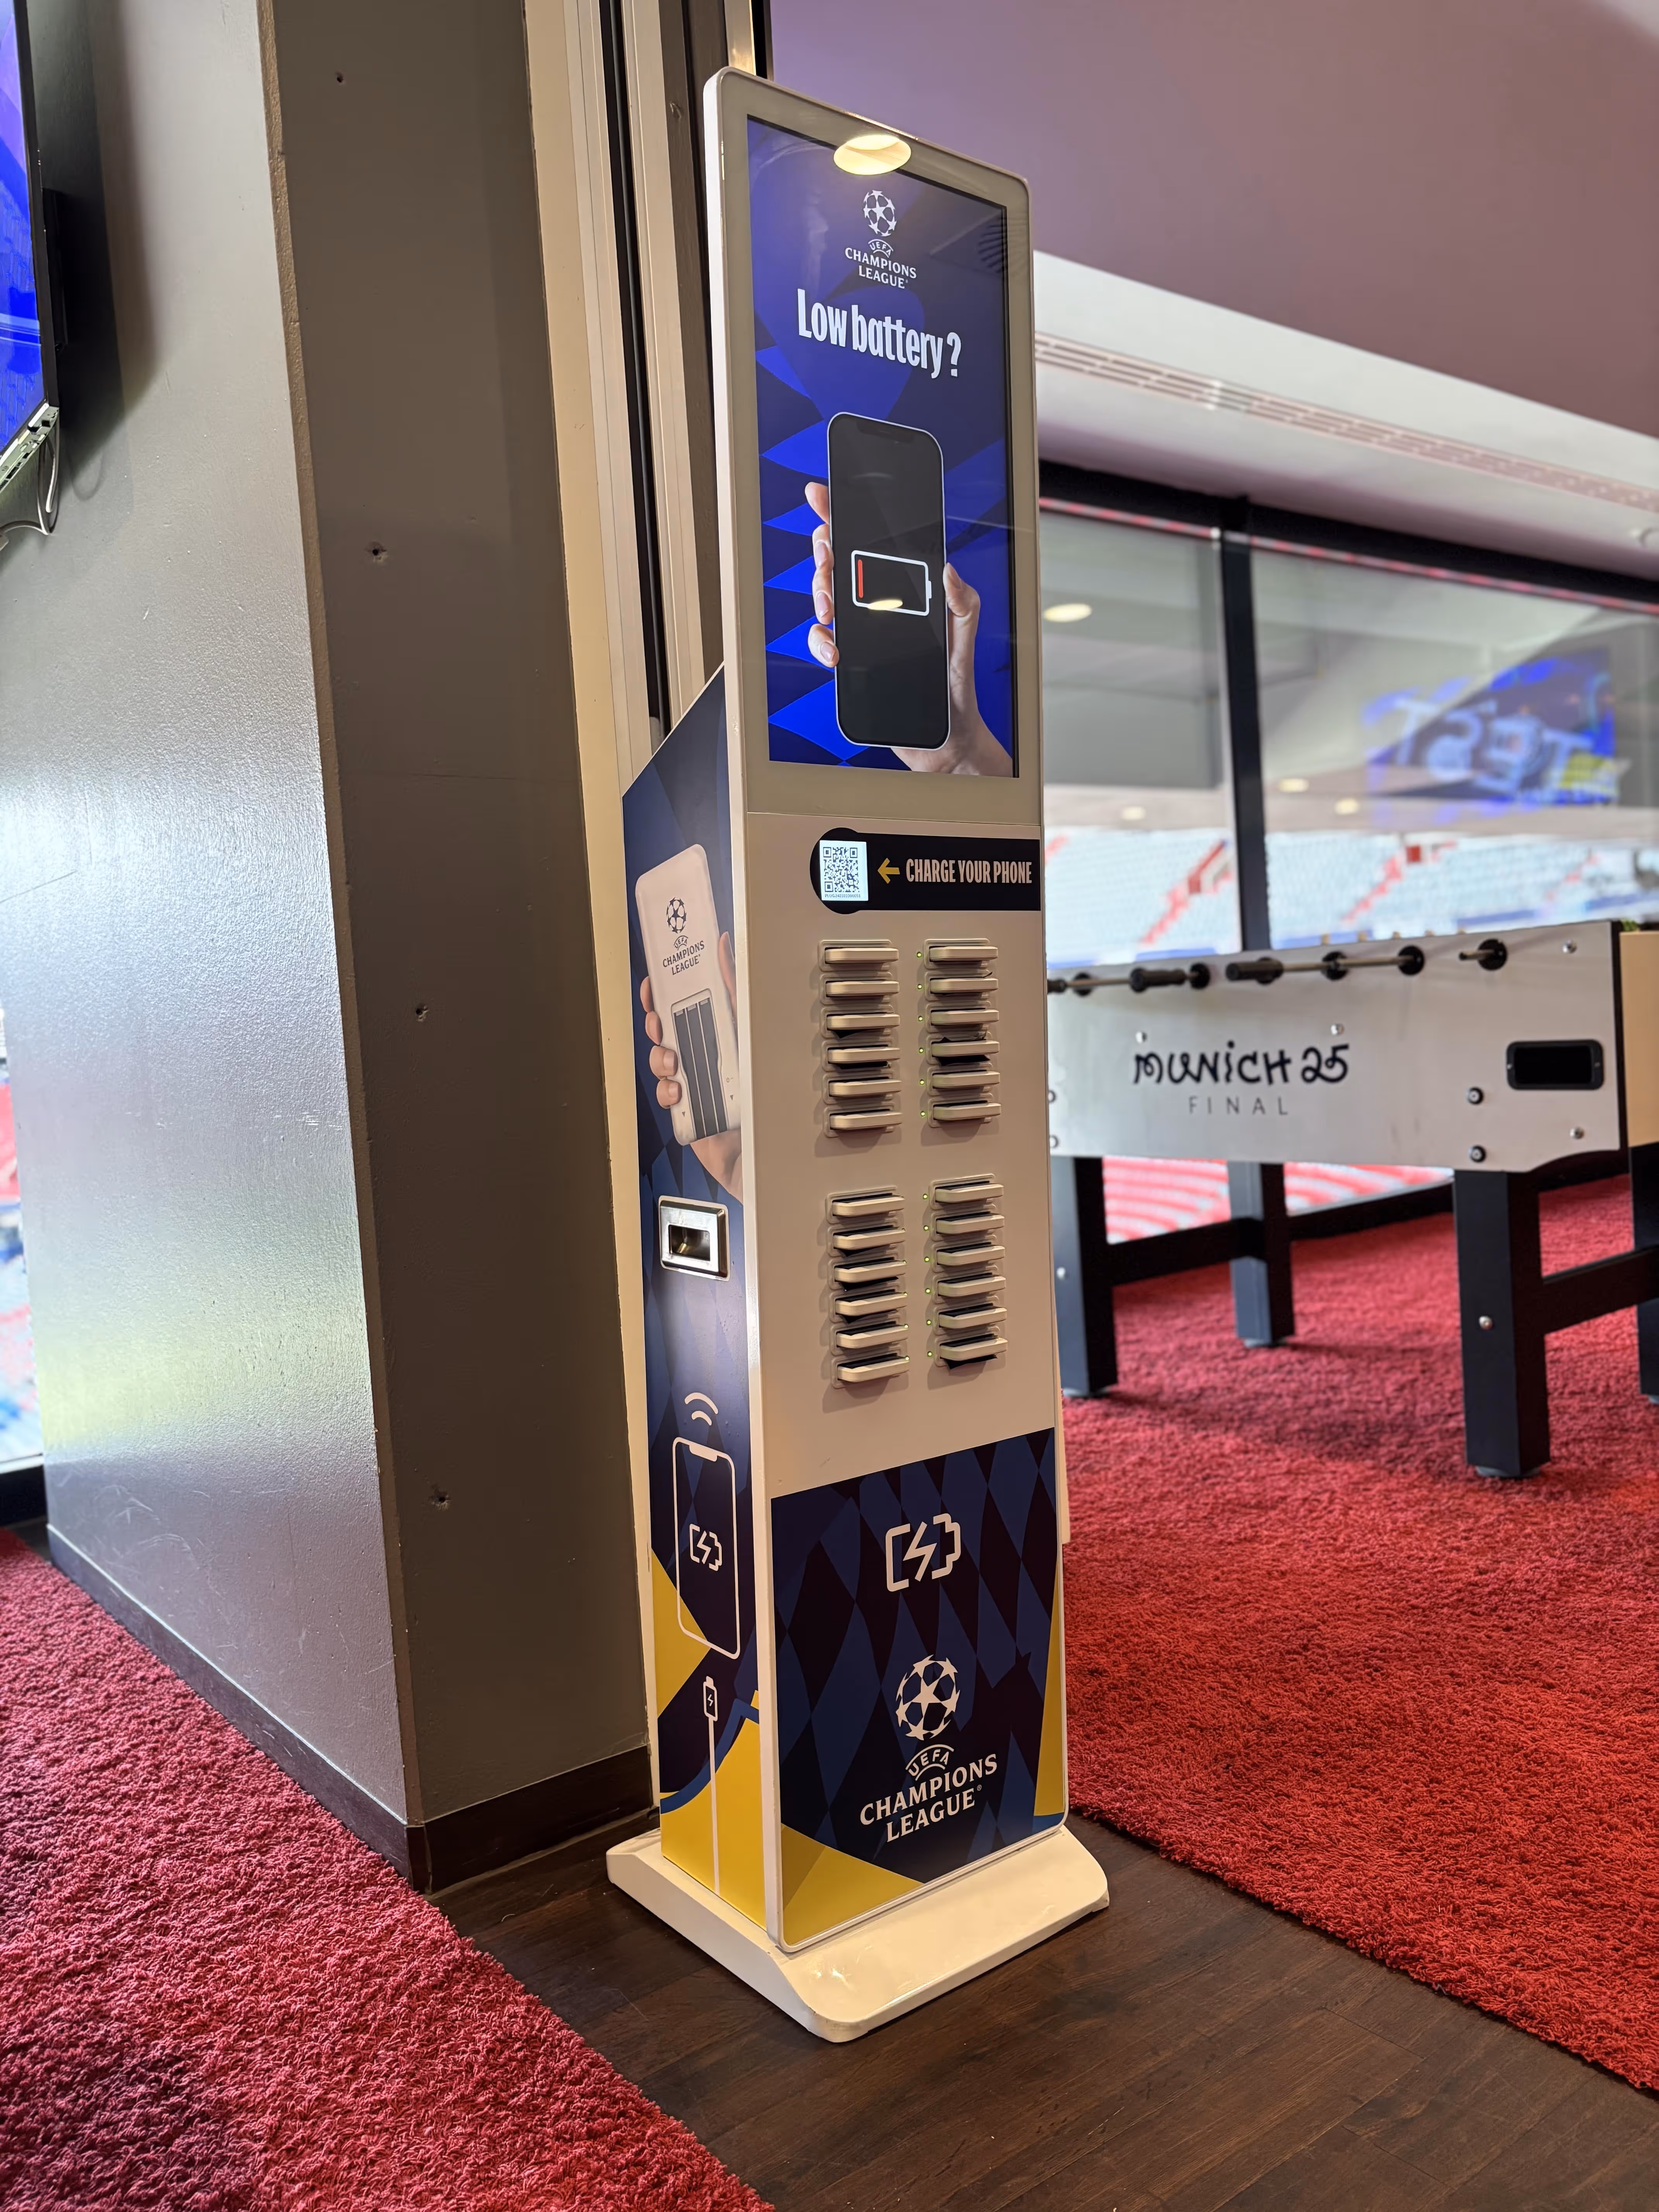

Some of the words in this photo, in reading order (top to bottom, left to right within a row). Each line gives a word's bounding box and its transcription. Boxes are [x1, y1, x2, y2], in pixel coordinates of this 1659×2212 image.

[869, 241, 891, 256] UEFA
[845, 247, 917, 279] CHAMPIONS
[797, 288, 847, 347] Low
[851, 304, 944, 379] battery
[905, 858, 956, 883] CHARGE
[957, 860, 991, 883] YOUR
[993, 860, 1032, 884] PHONE
[663, 940, 705, 967] CHAMPIONS
[674, 937, 687, 949] UEFA
[1188, 1096, 1288, 1115] FINAL
[907, 1748, 949, 1777] UEFA
[860, 1753, 998, 1825] CHAMPIONS
